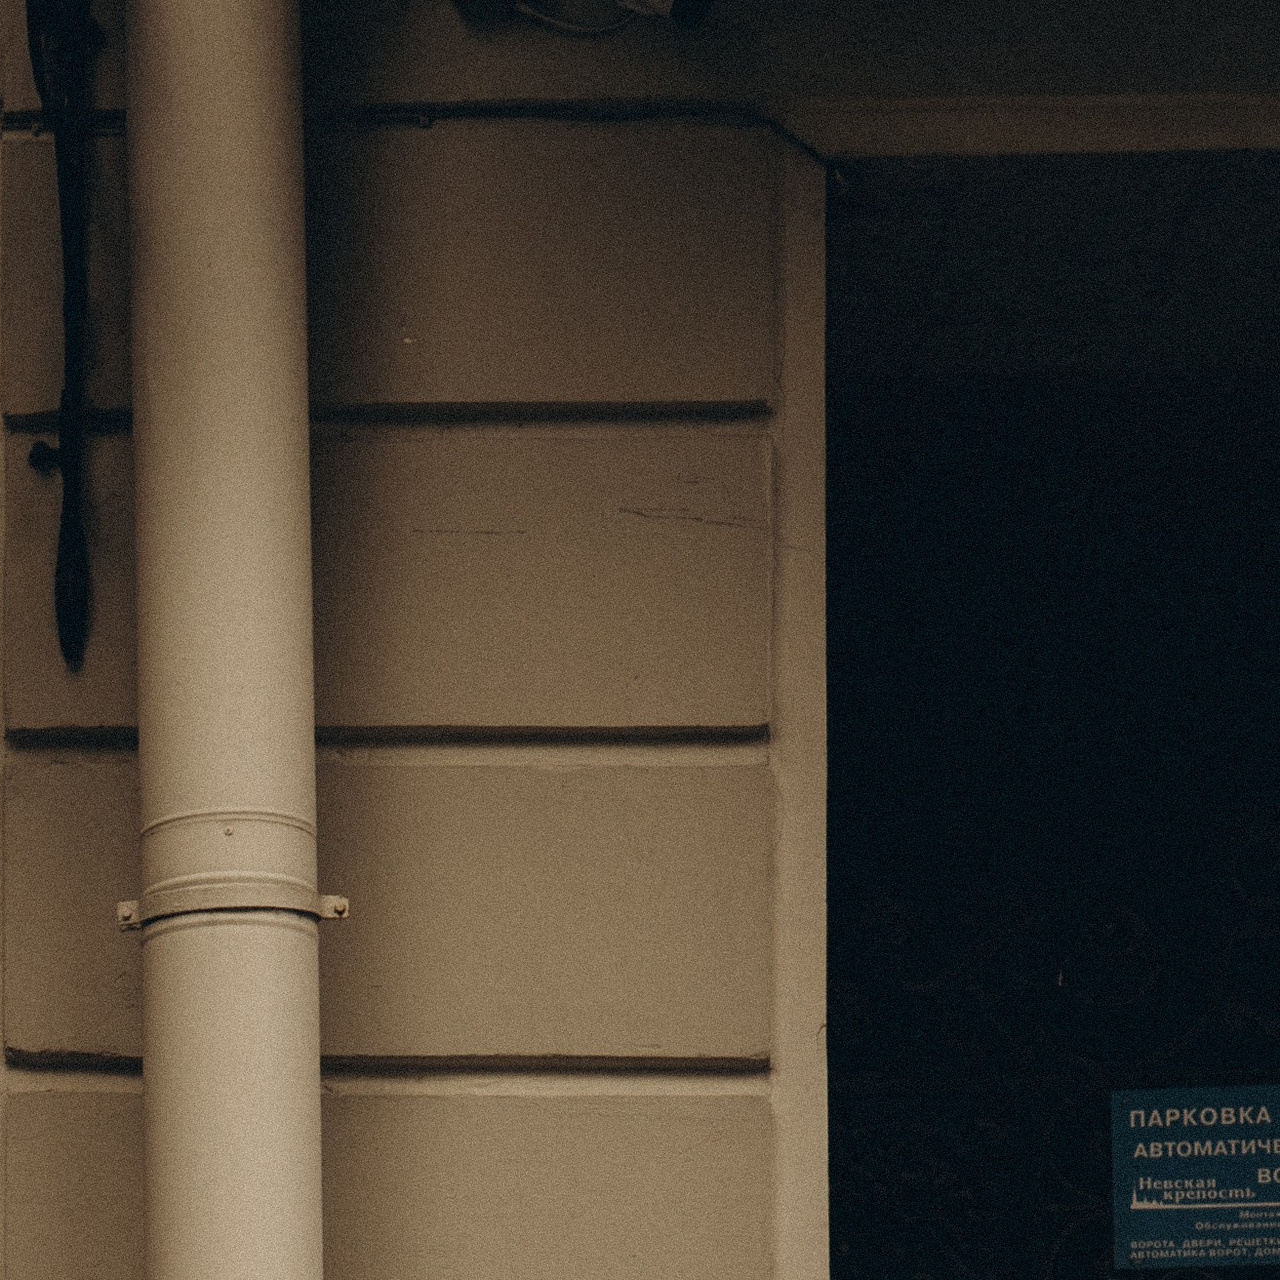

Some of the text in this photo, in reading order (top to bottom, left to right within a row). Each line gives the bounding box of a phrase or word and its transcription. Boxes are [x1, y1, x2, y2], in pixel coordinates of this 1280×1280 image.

[1130, 1106, 1271, 1128] ПАРКОВКА
[1139, 1177, 1216, 1190] Невская
[1163, 1188, 1256, 1203] крепость
